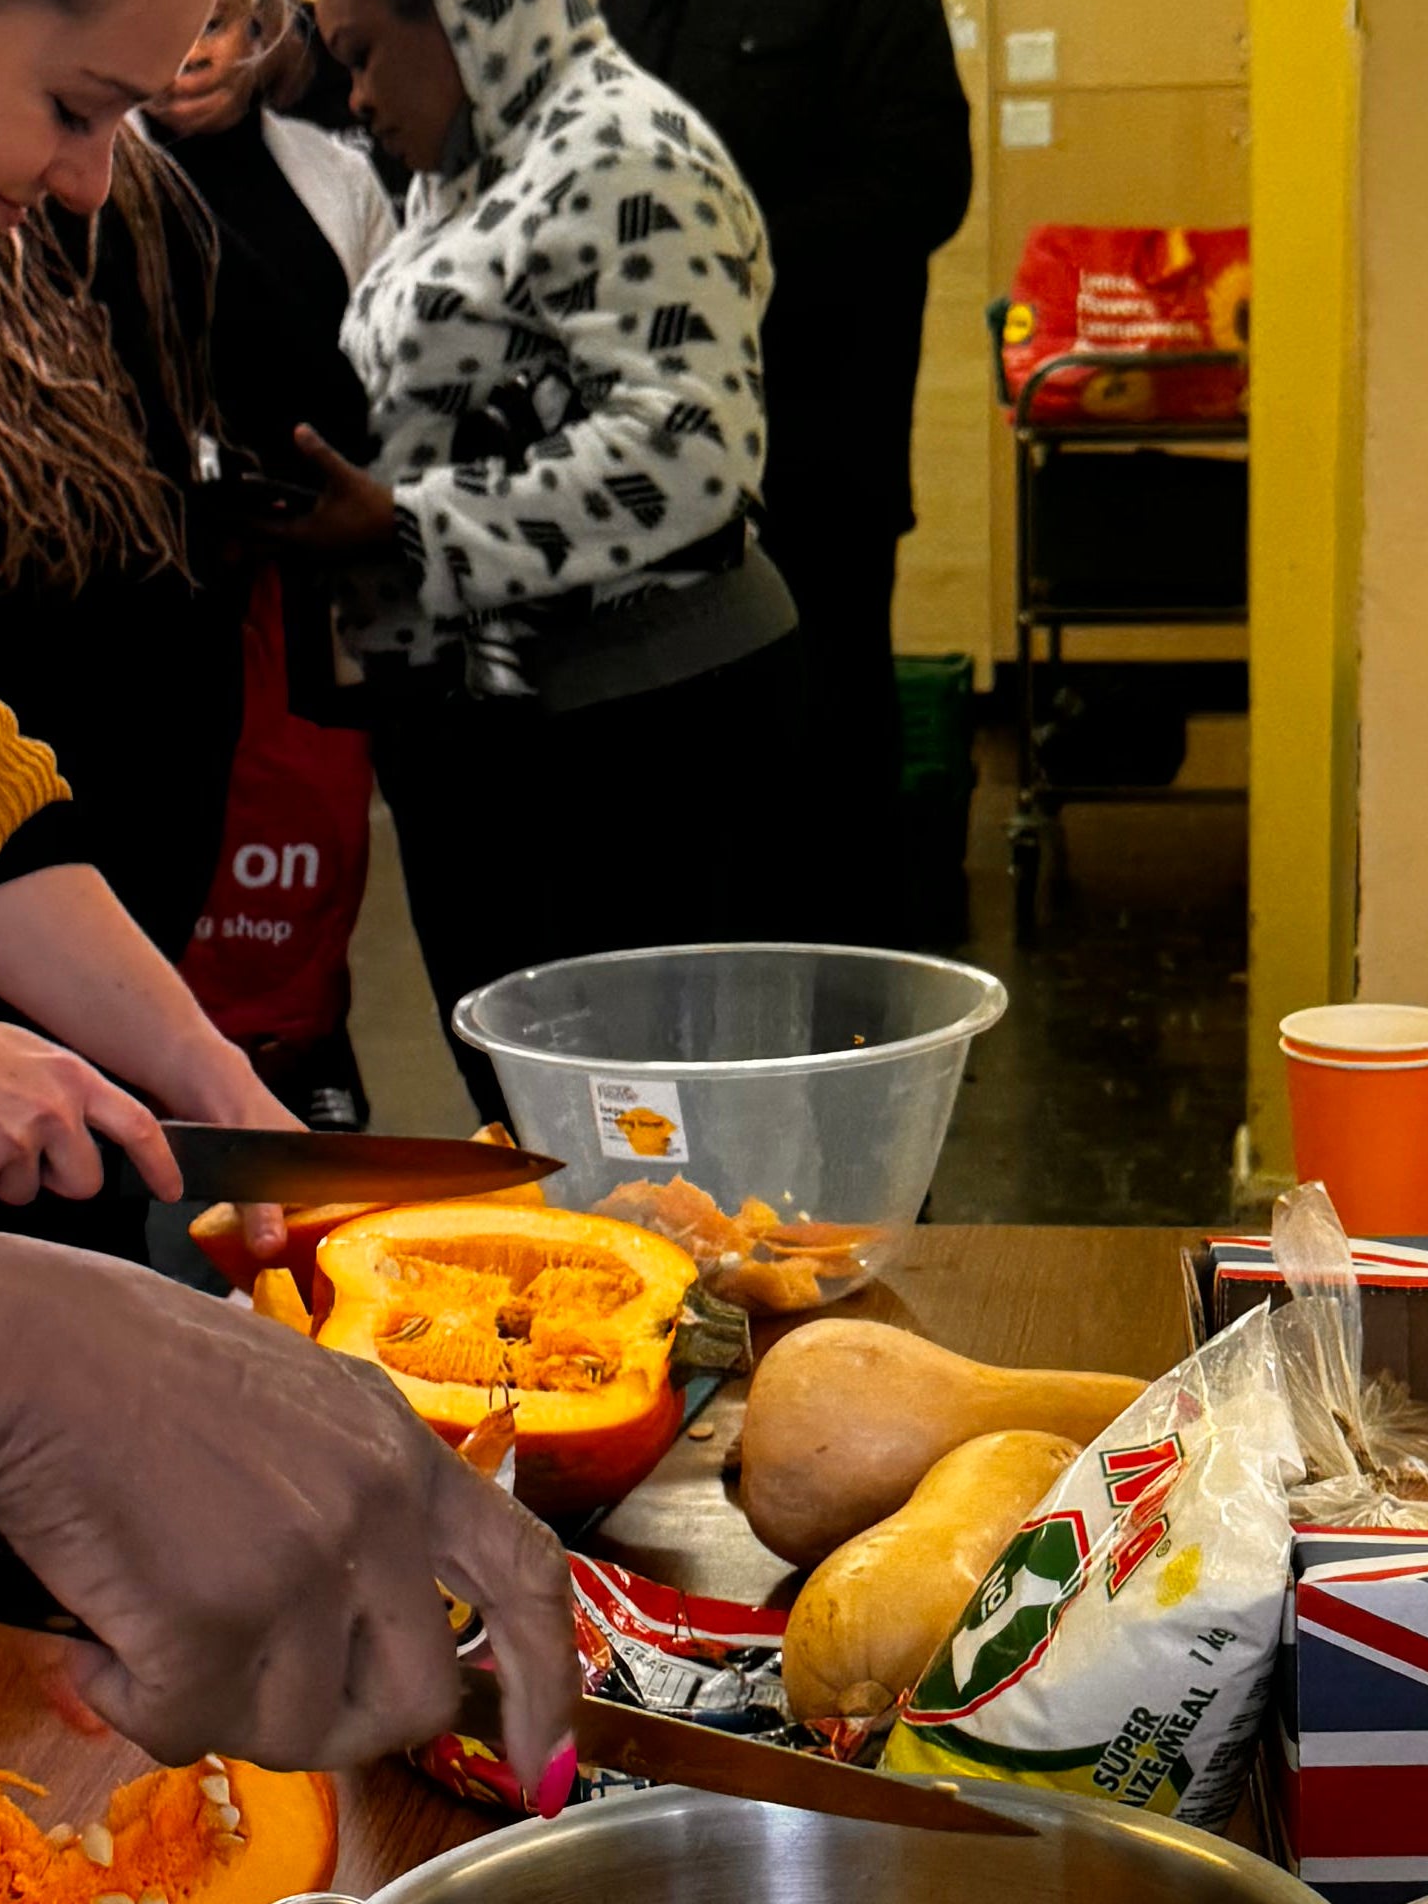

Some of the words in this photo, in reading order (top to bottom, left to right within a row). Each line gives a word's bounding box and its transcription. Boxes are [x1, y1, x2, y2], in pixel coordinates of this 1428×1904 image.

[233, 843, 319, 890] on
[222, 912, 293, 947] shop
[1188, 1648, 1214, 1666] 1
[1196, 1628, 1238, 1652] kg
[1154, 1687, 1219, 1759] MEAL
[1092, 1706, 1163, 1793] SUPER
